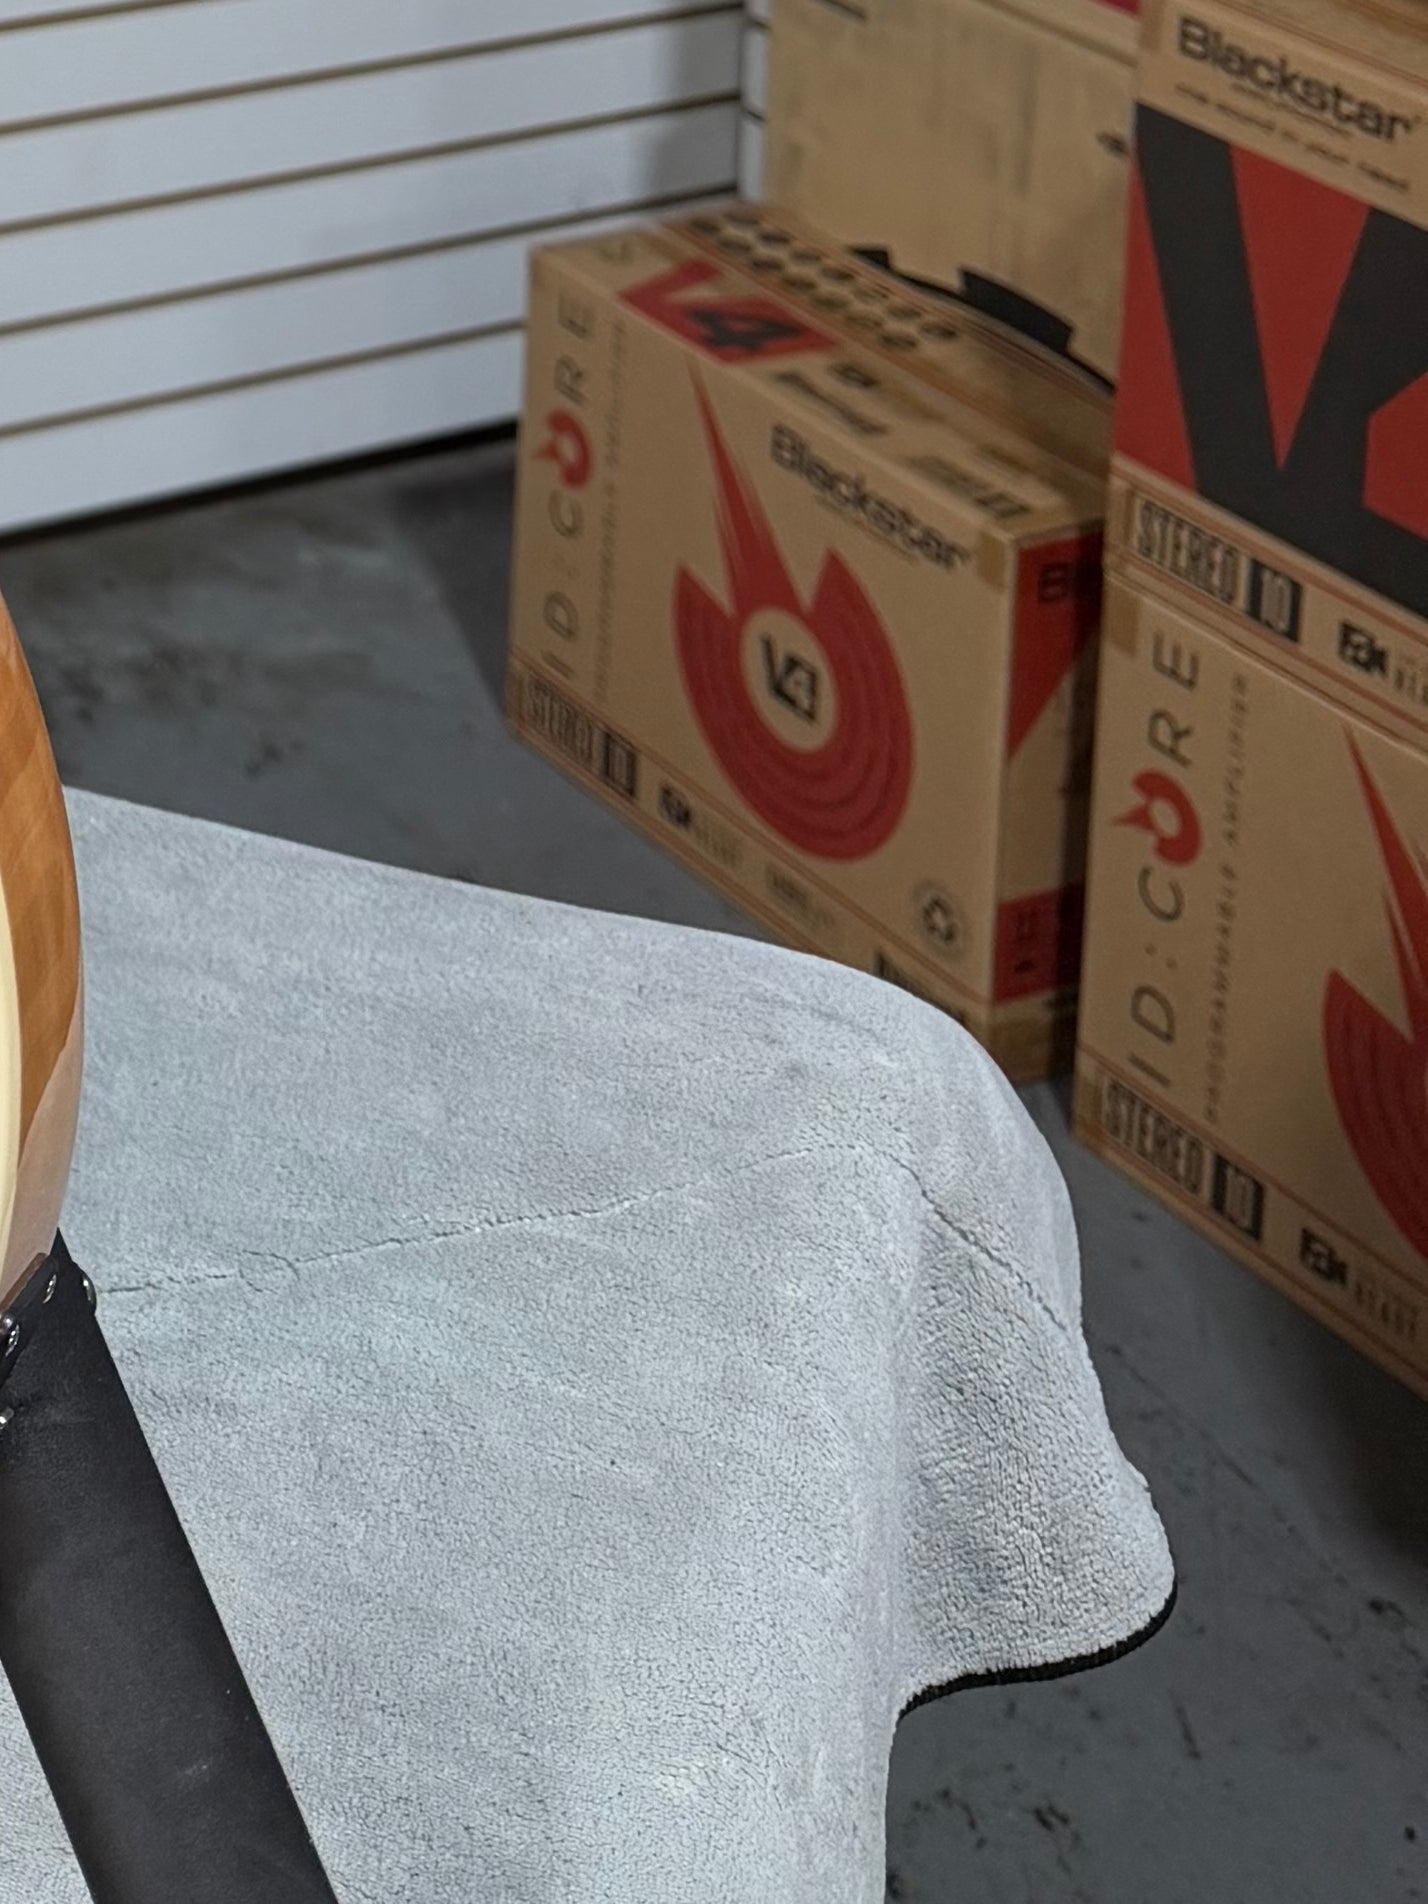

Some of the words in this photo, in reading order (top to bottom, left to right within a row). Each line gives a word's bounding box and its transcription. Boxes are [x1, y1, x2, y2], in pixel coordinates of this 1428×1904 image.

[1178, 14, 1414, 141] Blackstar
[770, 422, 971, 569] Blackstar
[1137, 499, 1239, 605] STEREO
